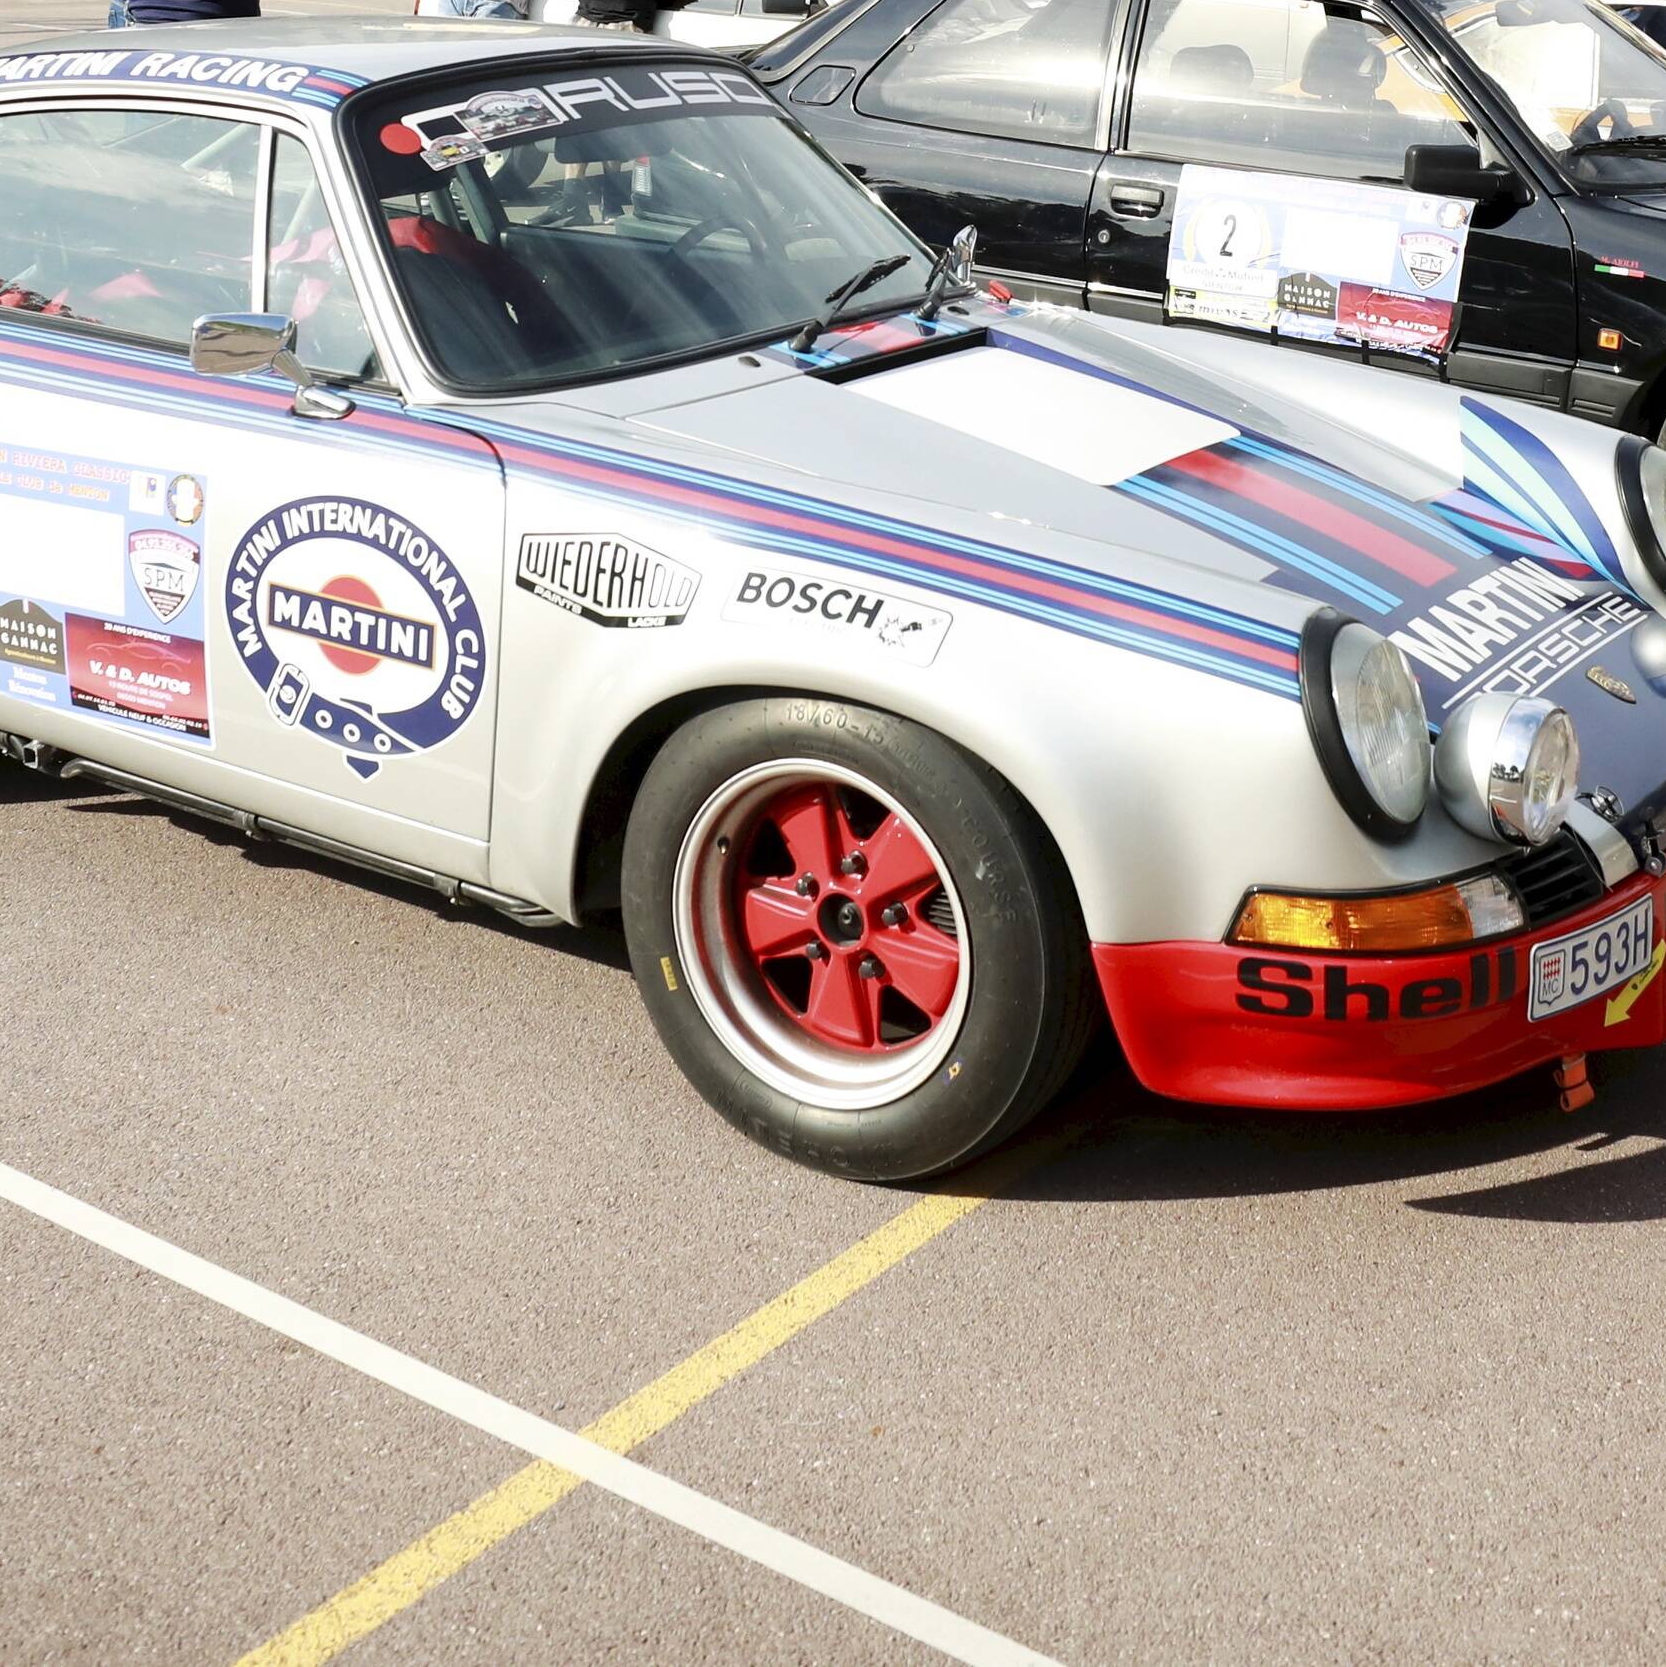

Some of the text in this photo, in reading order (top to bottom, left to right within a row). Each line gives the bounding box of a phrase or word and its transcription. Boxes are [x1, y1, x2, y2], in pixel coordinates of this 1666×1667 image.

[130, 52, 310, 93] RACING
[1219, 214, 1237, 257] 2
[1411, 255, 1443, 272] SPM
[1284, 284, 1331, 299] MAISON
[1394, 319, 1438, 334] AUTOS
[12, 453, 67, 474] RIVIERA
[144, 567, 184, 592] SPM
[526, 541, 693, 608] WIEDERHOLD
[231, 502, 479, 720] MARTINI INTERNATIONAL CLUB
[533, 584, 583, 615] PAINTS
[736, 572, 884, 629] BOSCH
[0, 617, 56, 640] MAISON
[273, 591, 429, 662] MARTINI
[1387, 556, 1585, 682] MARTINI
[0, 632, 58, 655] GANNAC
[1467, 596, 1641, 697] ORSCHE
[89, 660, 191, 696] V. & D. AUTOS
[1570, 907, 1649, 995] 593H
[1235, 946, 1517, 1021] Shell
[1543, 978, 1559, 997] MC
